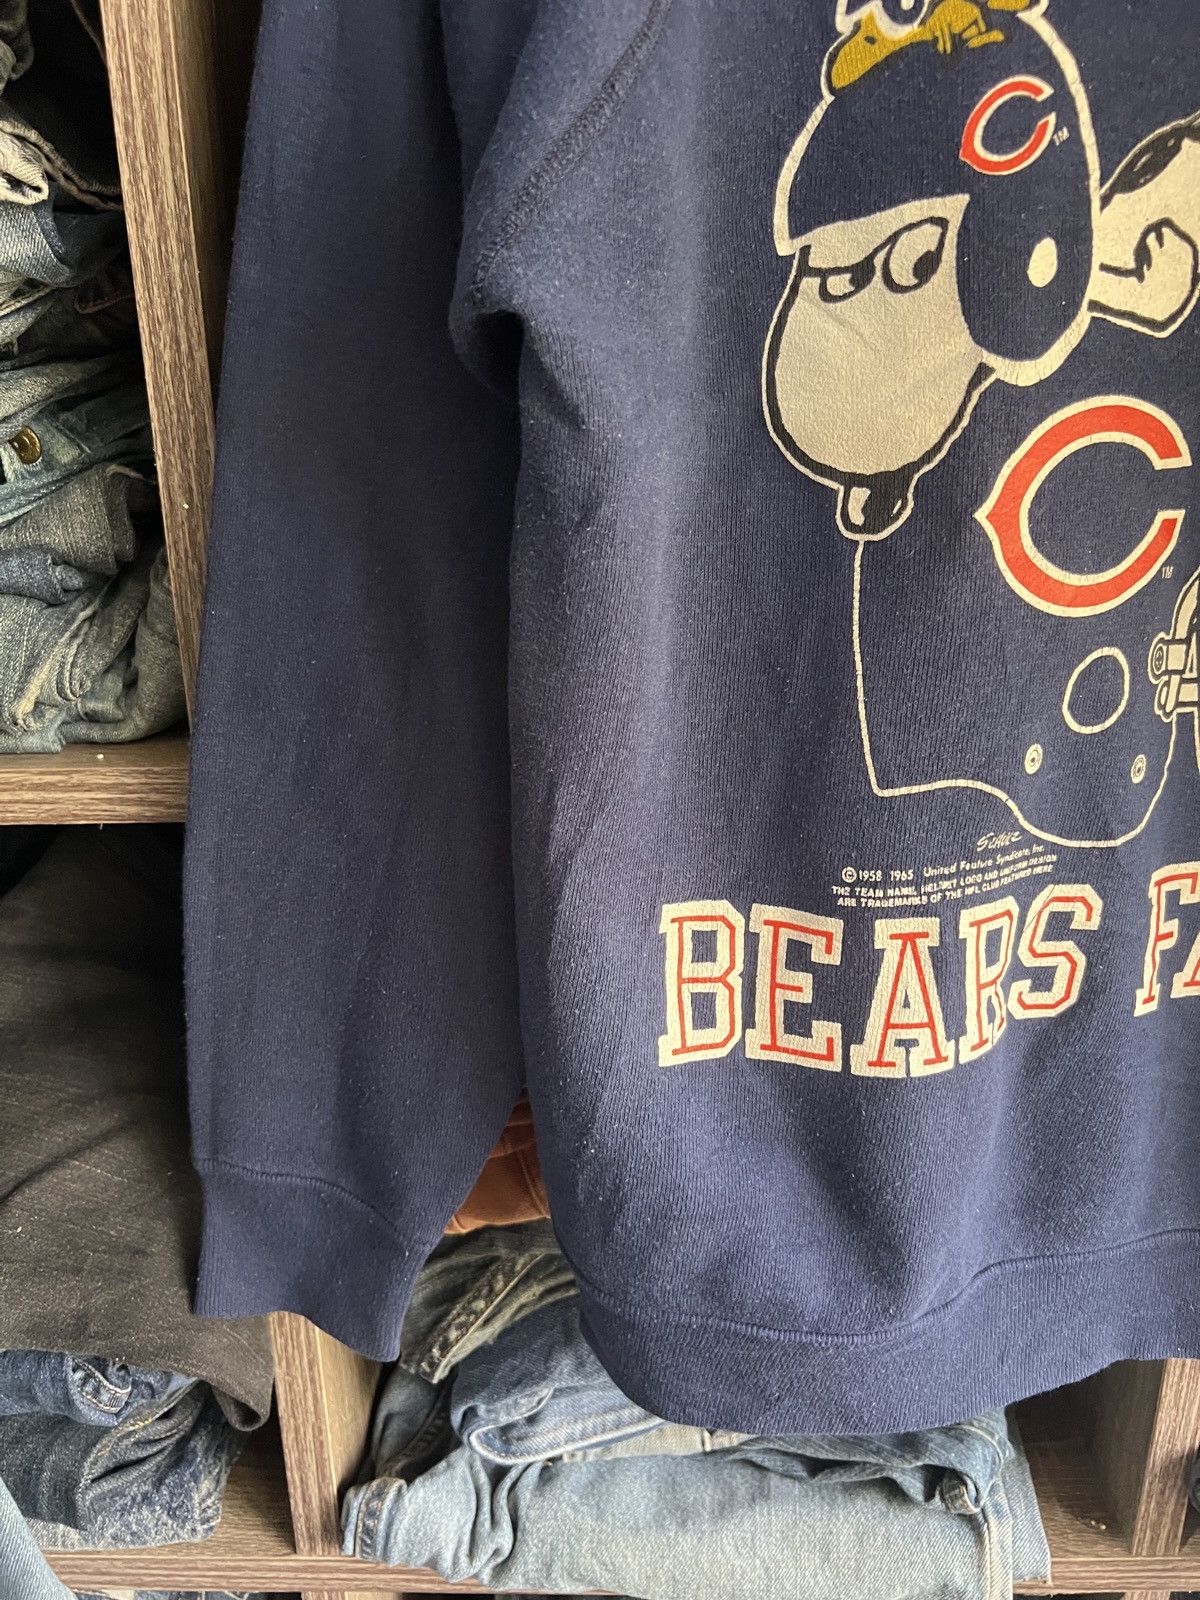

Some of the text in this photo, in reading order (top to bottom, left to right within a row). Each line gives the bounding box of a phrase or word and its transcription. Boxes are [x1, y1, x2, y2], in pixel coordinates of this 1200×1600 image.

[959, 74, 1056, 176] C
[973, 395, 1192, 617] C
[831, 885, 851, 896] THE
[854, 887, 884, 898] TEAM
[984, 870, 999, 881] AND
[837, 897, 857, 907] ARE
[930, 892, 943, 903] OF
[945, 888, 963, 900] THE
[964, 885, 981, 896] NFL
[982, 879, 1000, 892] CLUB
[890, 869, 914, 881] 1965
[923, 862, 957, 877] United
[960, 858, 993, 871] Feature
[658, 884, 1104, 1079] BEARS
